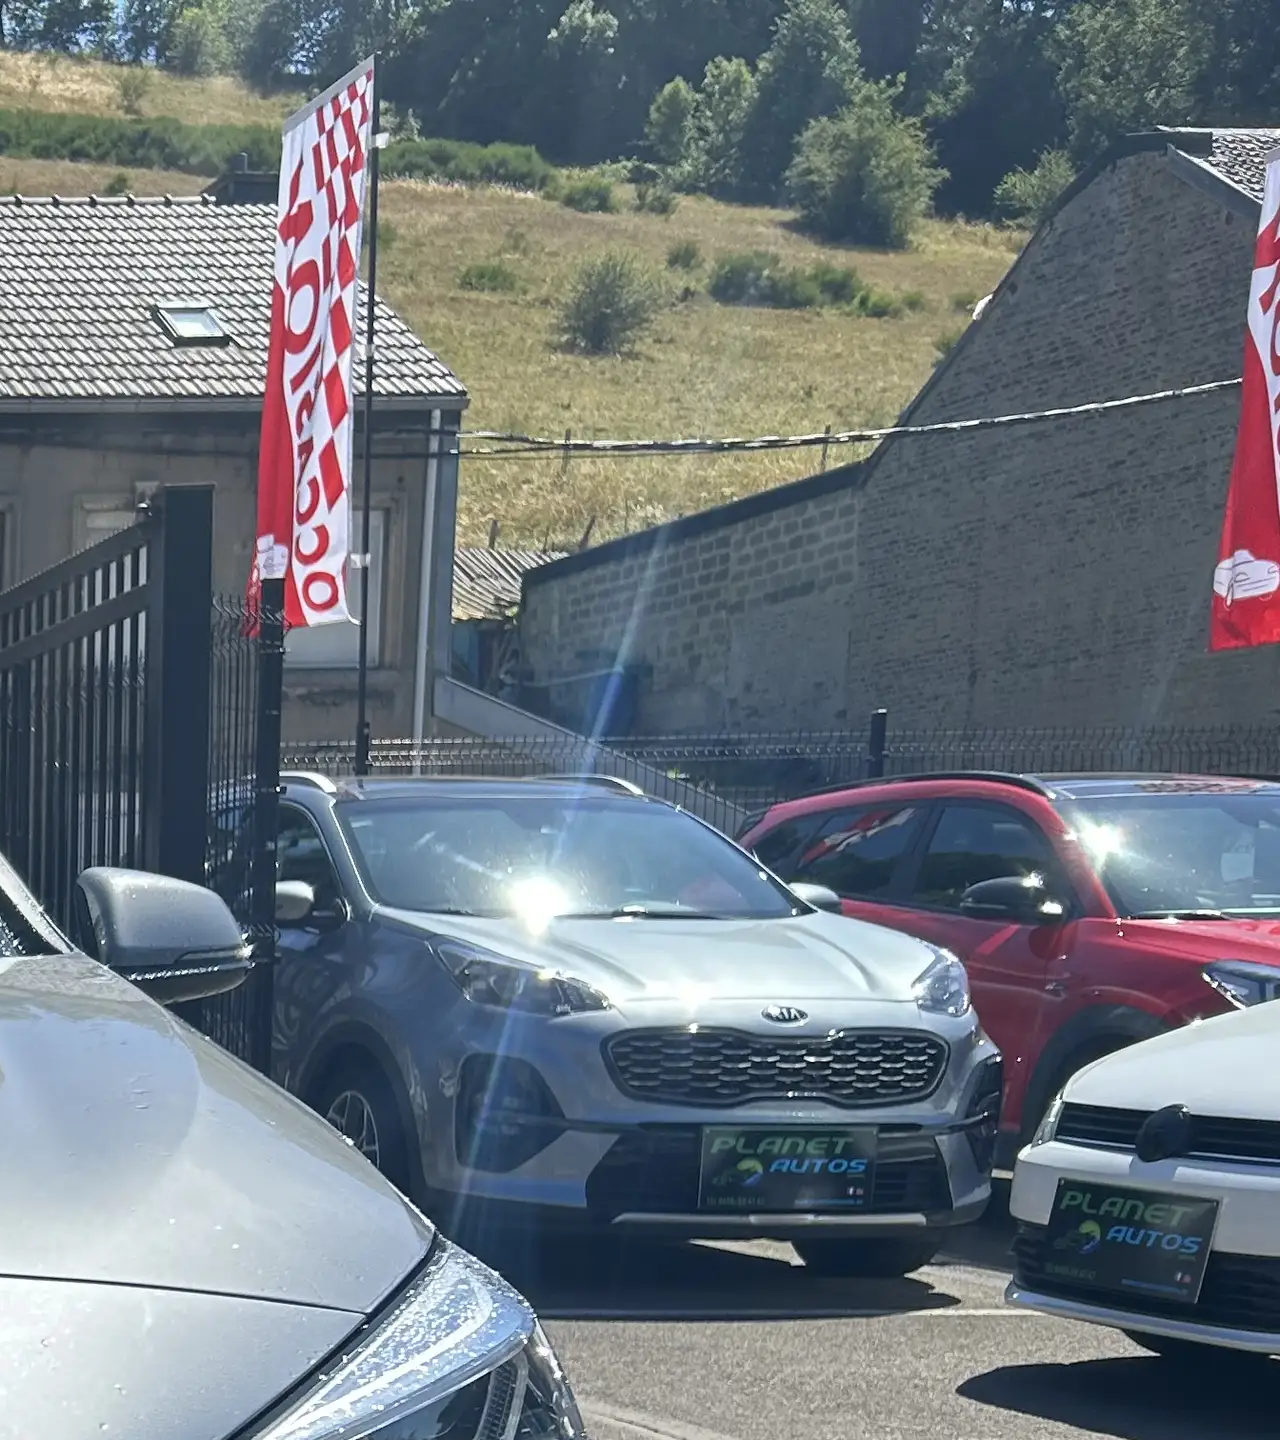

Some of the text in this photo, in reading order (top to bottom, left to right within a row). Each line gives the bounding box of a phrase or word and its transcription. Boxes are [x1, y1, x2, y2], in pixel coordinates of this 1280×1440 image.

[710, 1136, 854, 1155] PLANET
[769, 1158, 868, 1174] AUTOS
[1059, 1190, 1193, 1228] PLANET
[1106, 1225, 1203, 1254] AUTOS
